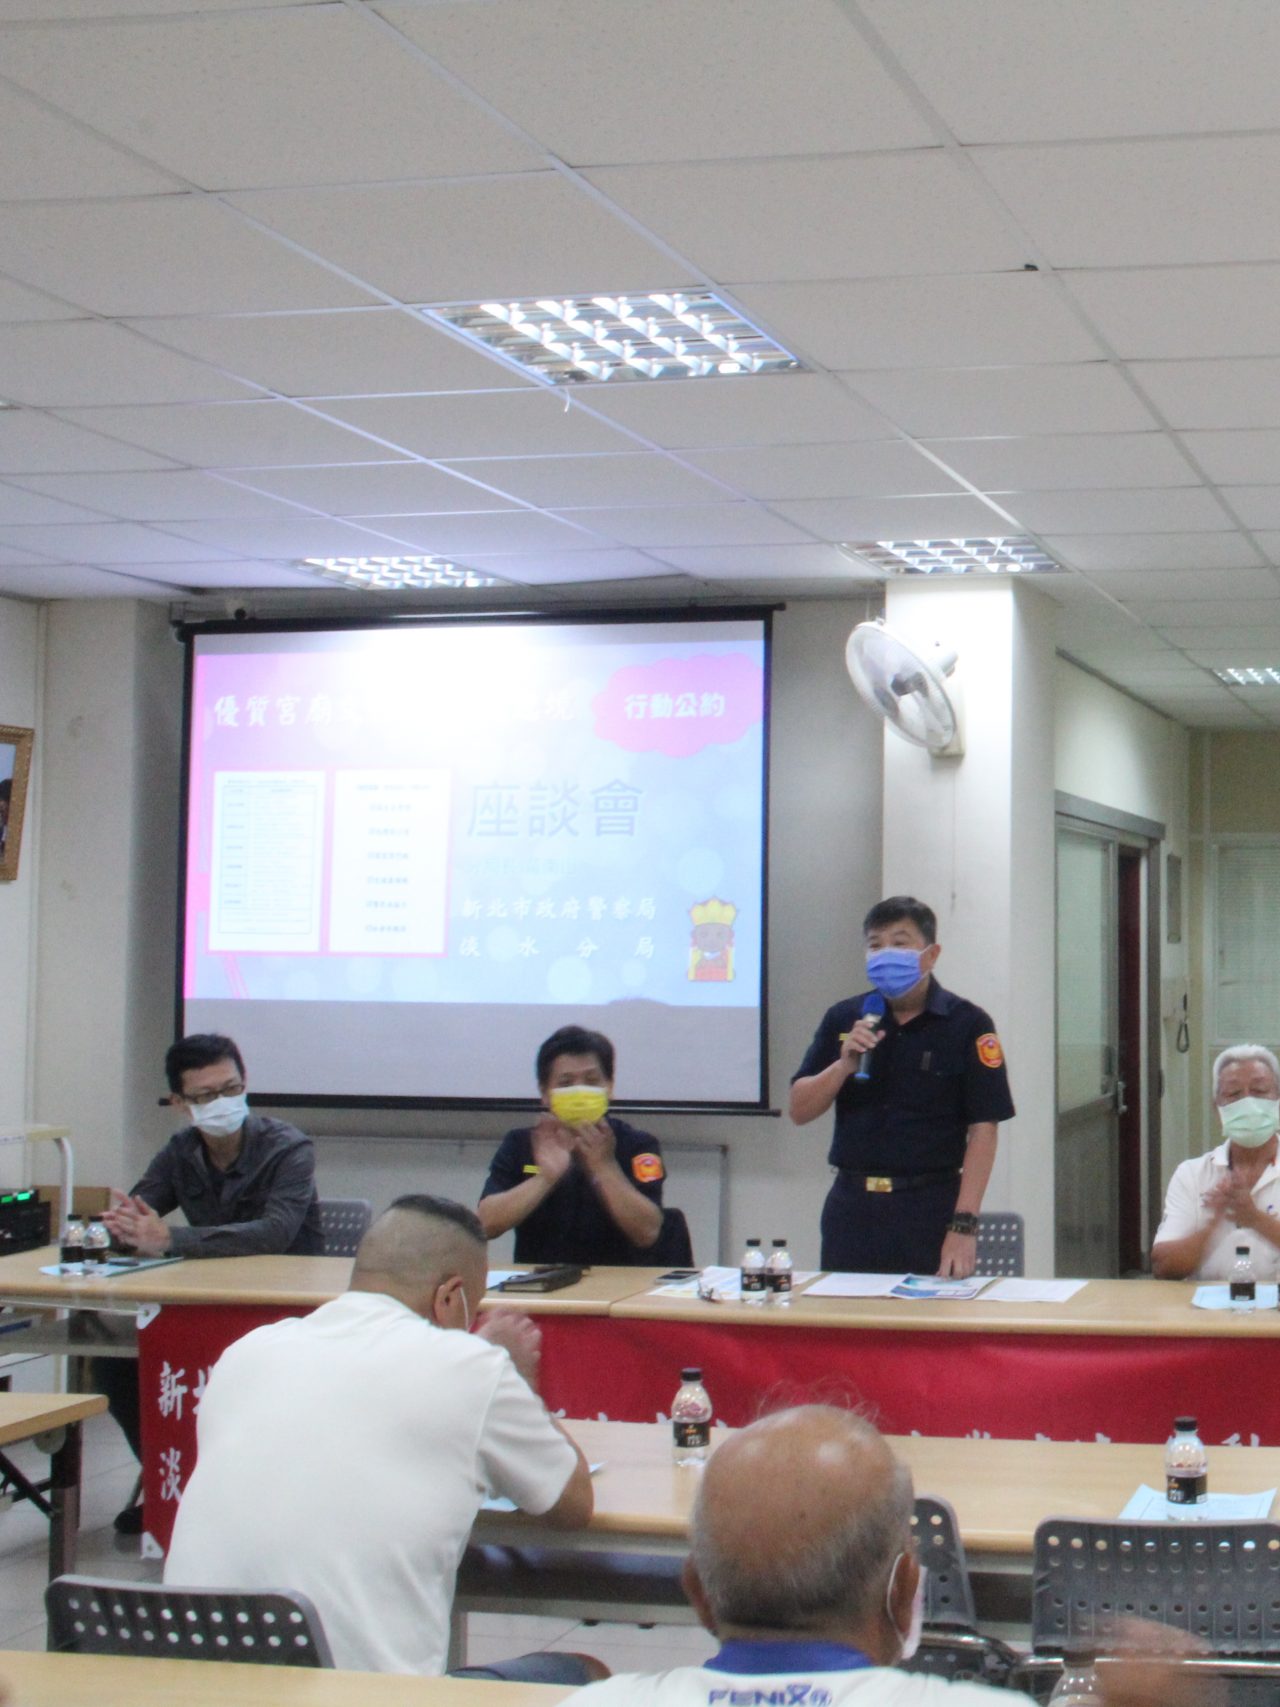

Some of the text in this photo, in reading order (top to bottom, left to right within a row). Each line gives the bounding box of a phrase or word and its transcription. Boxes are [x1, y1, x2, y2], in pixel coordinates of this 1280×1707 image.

[624, 692, 726, 720] 行動公約
[467, 778, 644, 838] 座談會
